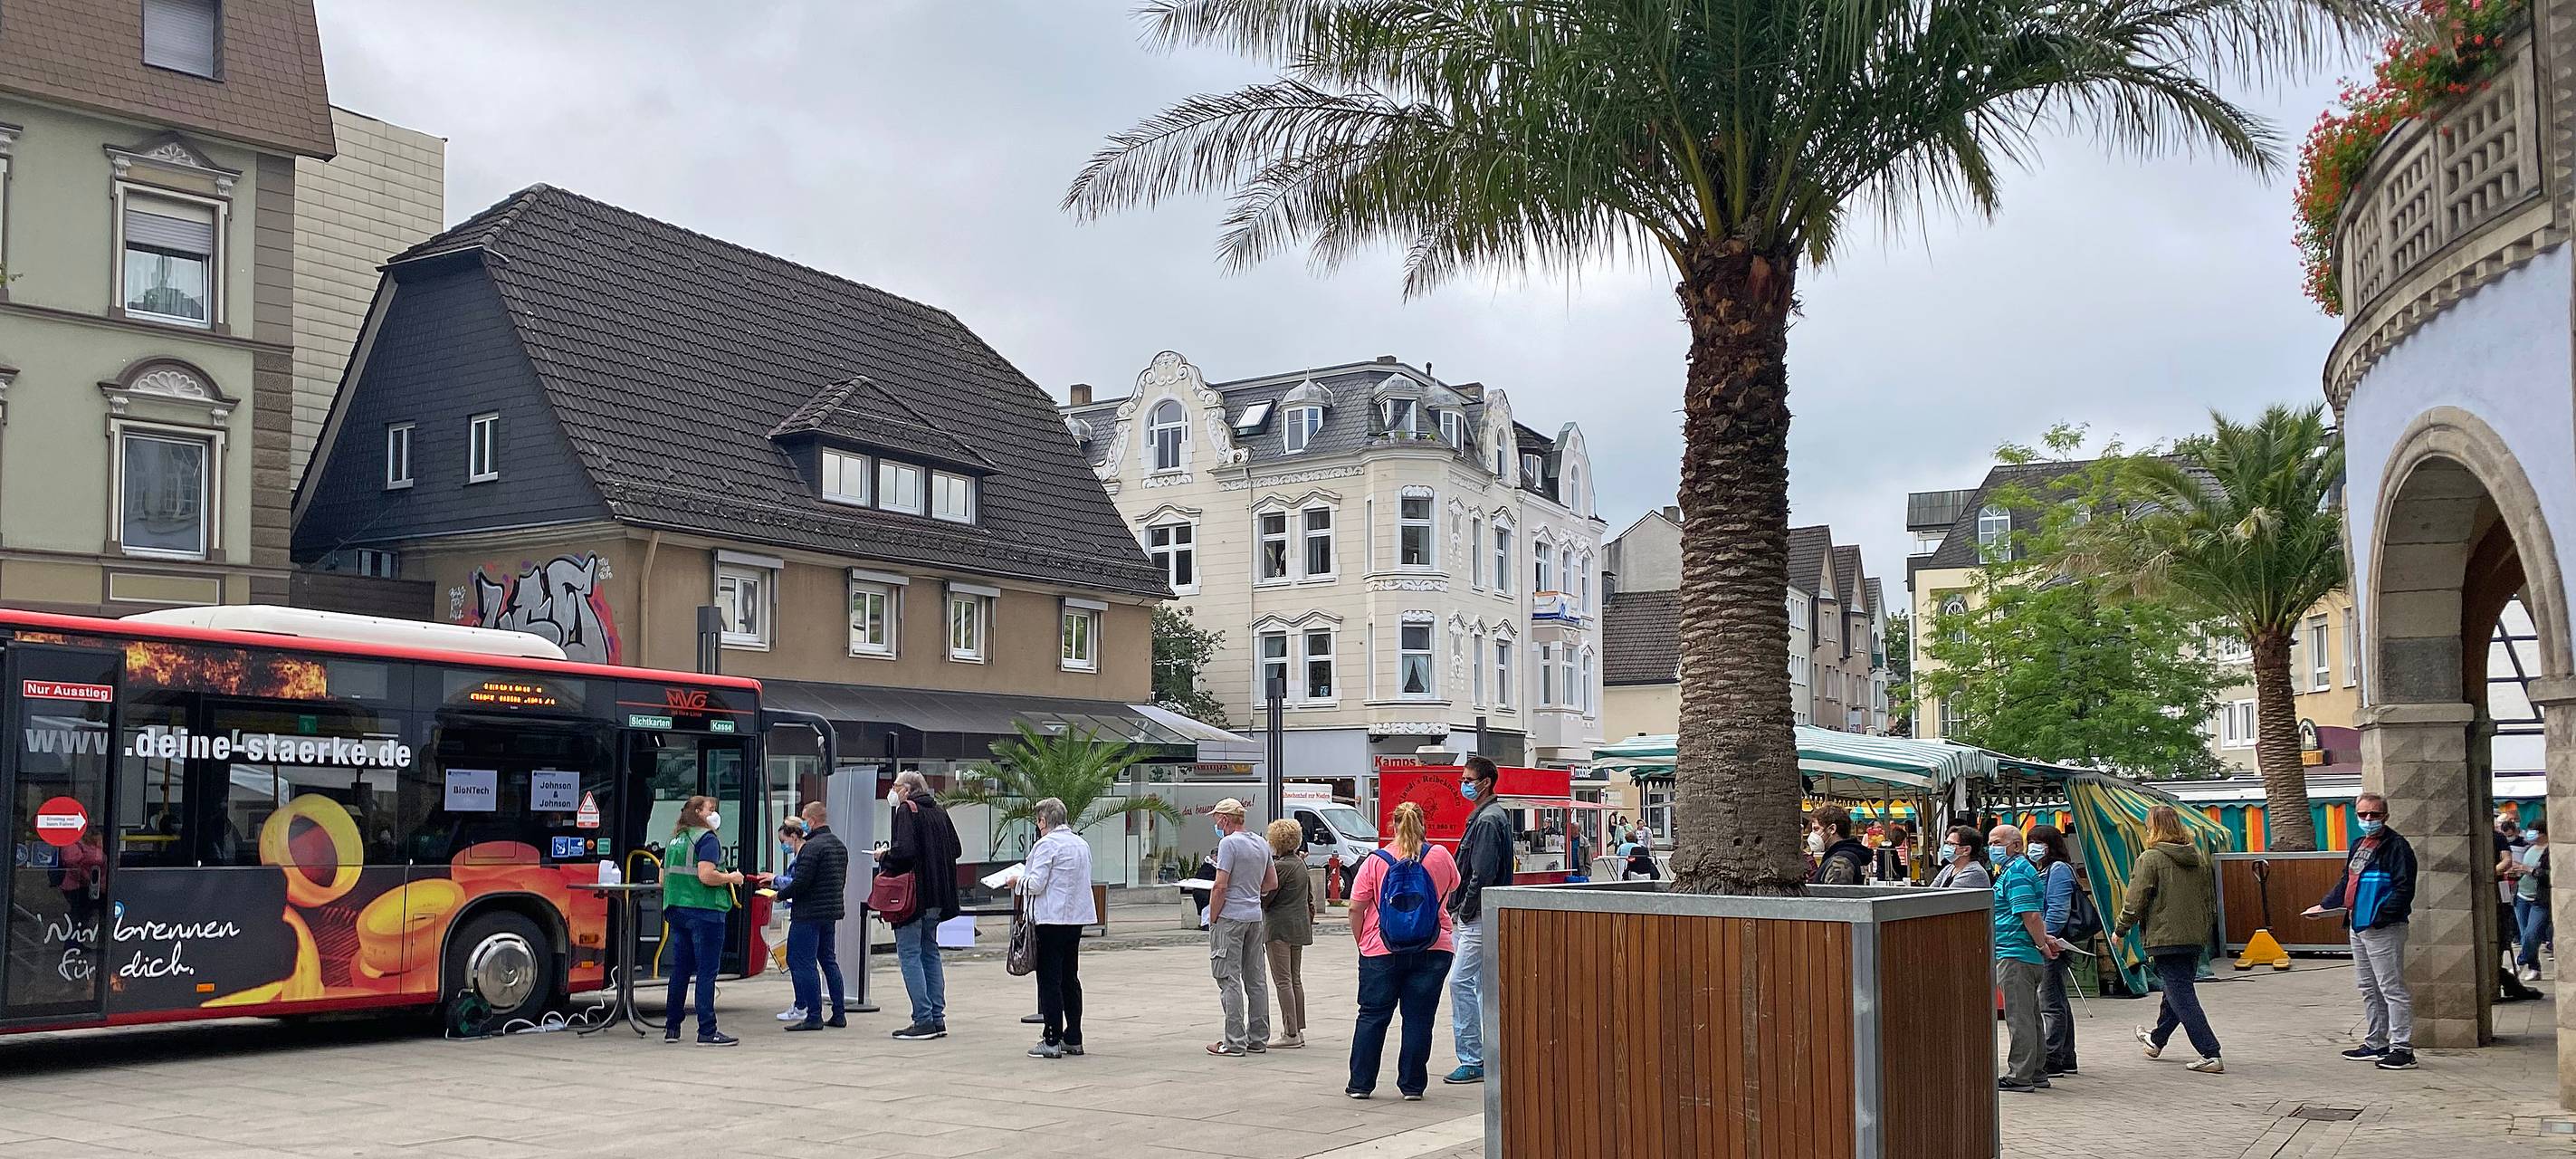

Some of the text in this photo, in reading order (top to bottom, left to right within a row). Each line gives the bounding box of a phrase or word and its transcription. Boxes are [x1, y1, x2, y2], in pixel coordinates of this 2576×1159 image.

[27, 683, 109, 701] Nur Ausstieg
[665, 688, 710, 709] MVG
[631, 716, 671, 727] Sichtkarten
[712, 722, 732, 732] Kasse
[453, 785, 490, 795] BioNTech
[540, 781, 572, 790] Johnson
[539, 799, 571, 808] Johnson
[37, 913, 241, 943] Wir brennen
[57, 940, 196, 981] für dich.
